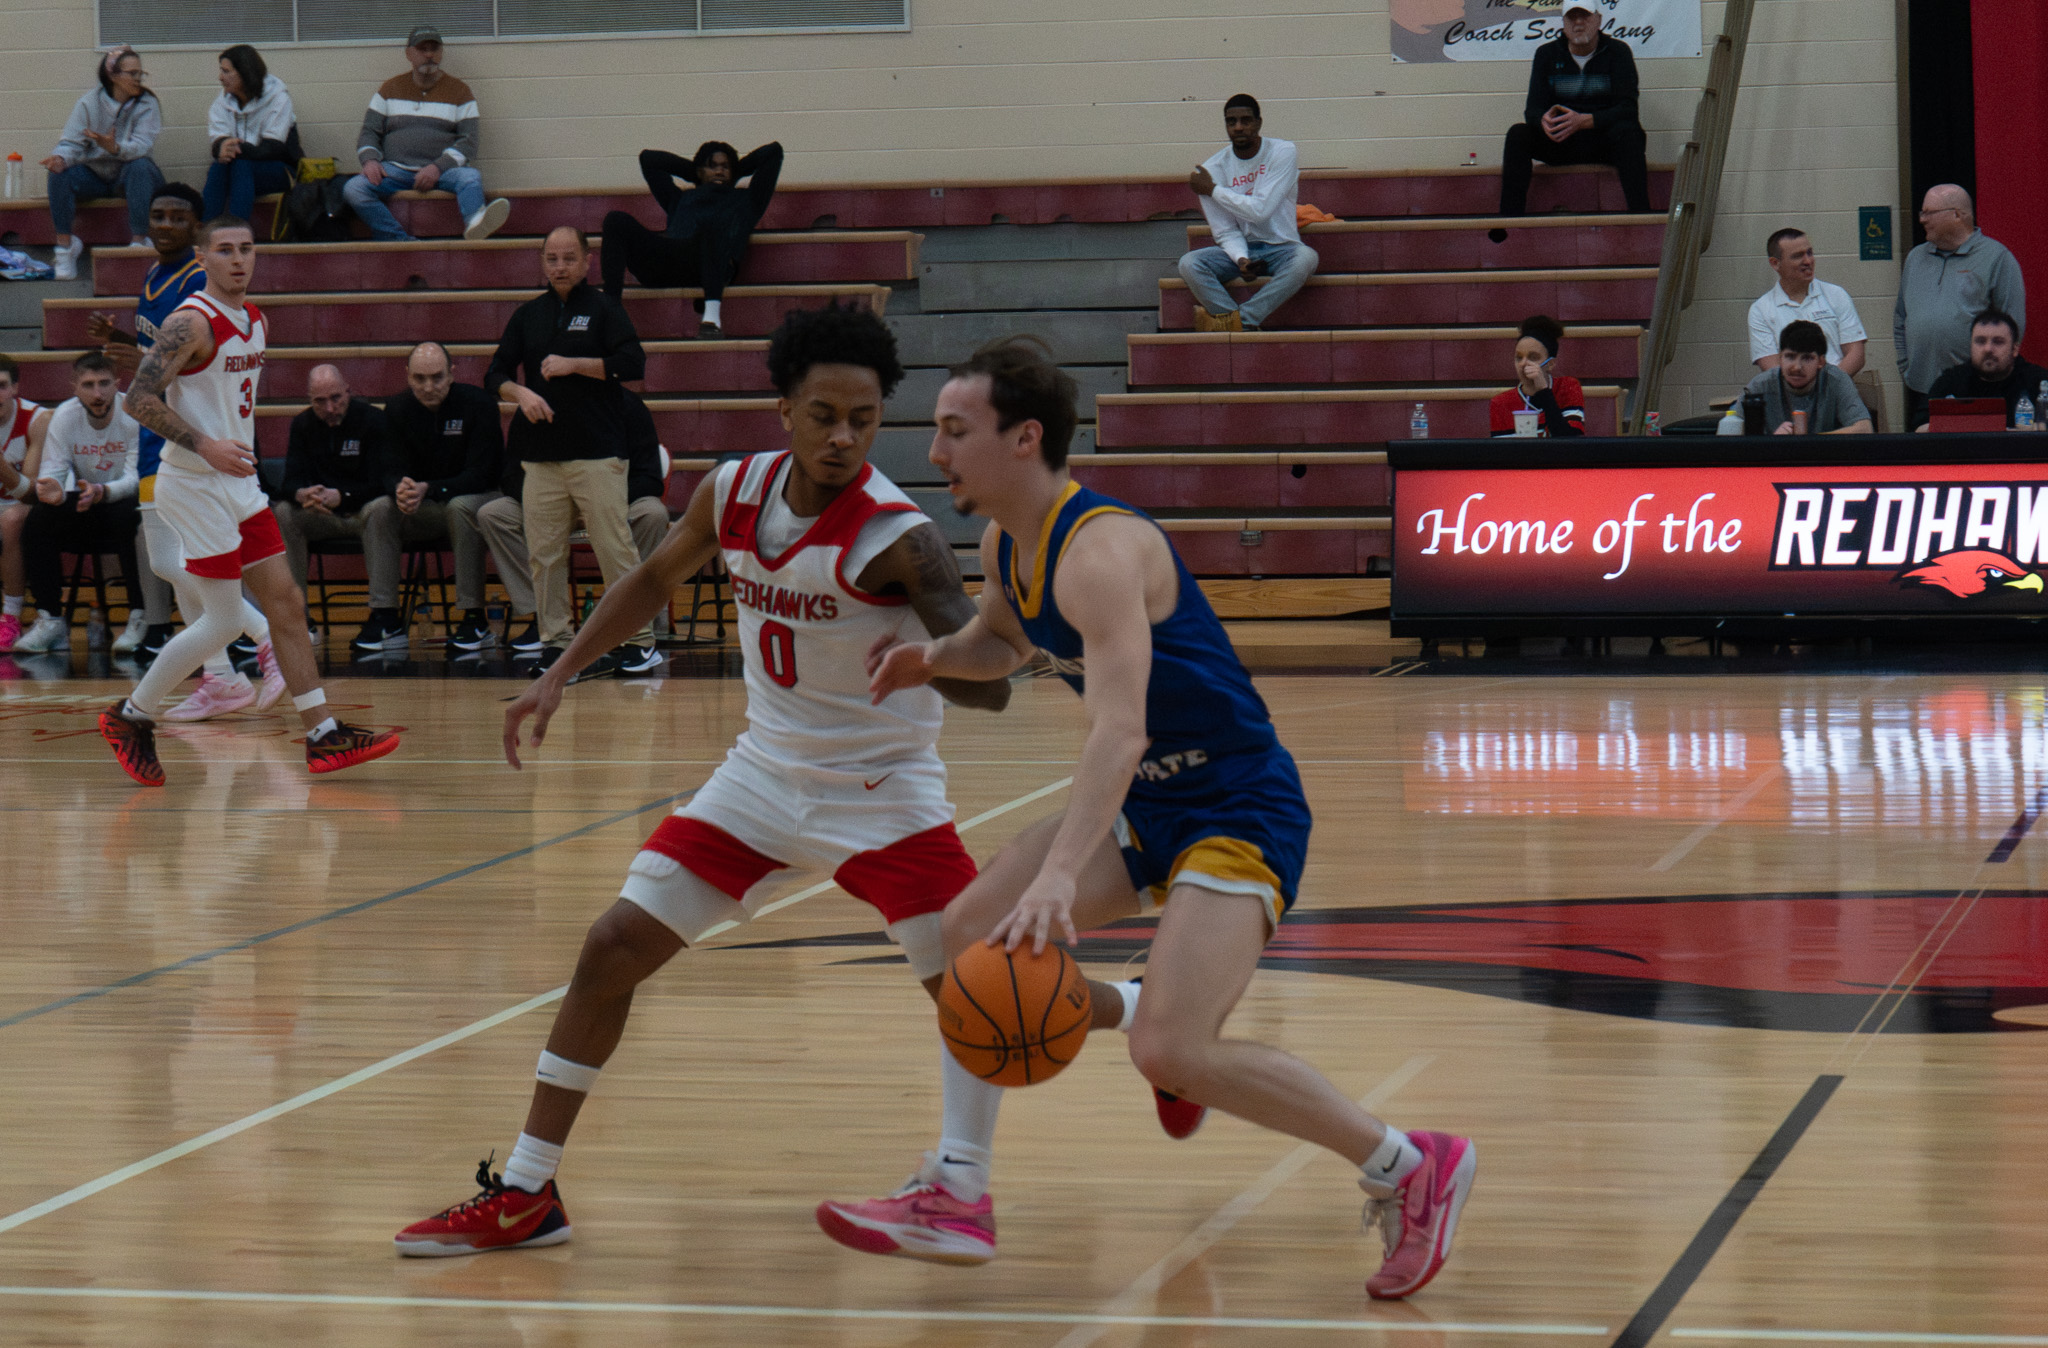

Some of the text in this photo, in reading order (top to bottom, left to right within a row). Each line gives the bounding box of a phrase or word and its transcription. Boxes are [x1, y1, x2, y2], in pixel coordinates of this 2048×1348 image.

[1444, 21, 1514, 45] Coach
[1524, 19, 1565, 40] Sco
[239, 377, 254, 419] 3
[1416, 492, 1574, 555] Home
[1592, 493, 1655, 580] of
[1659, 492, 1743, 553] the
[729, 570, 839, 621] EDHAWKS
[759, 619, 798, 689] 0
[1137, 749, 1209, 782] ATE
